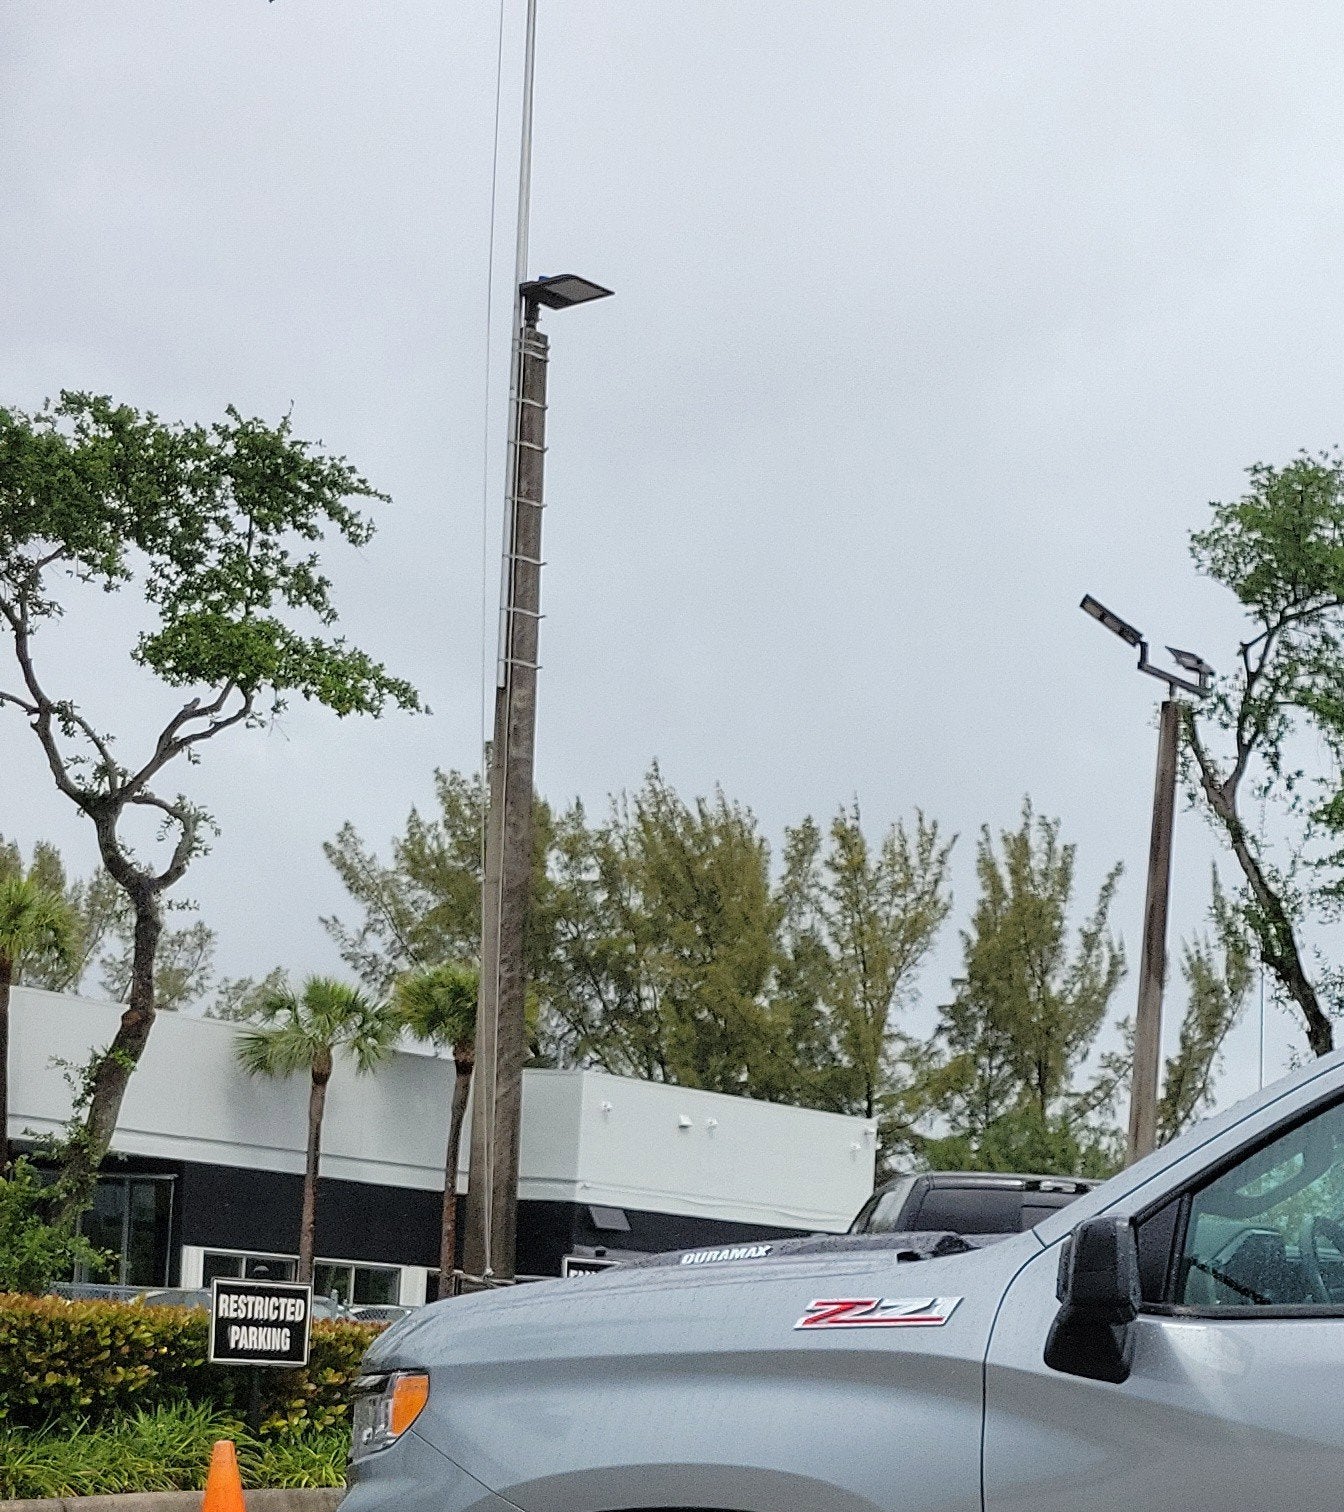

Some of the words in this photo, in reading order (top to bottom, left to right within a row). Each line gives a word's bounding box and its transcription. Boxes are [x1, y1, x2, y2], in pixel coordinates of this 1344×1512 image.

[681, 1244, 771, 1265] DURAMAX
[218, 1293, 305, 1323] RESTRICTED
[793, 1296, 964, 1331] Z71
[228, 1324, 291, 1353] PARKING
